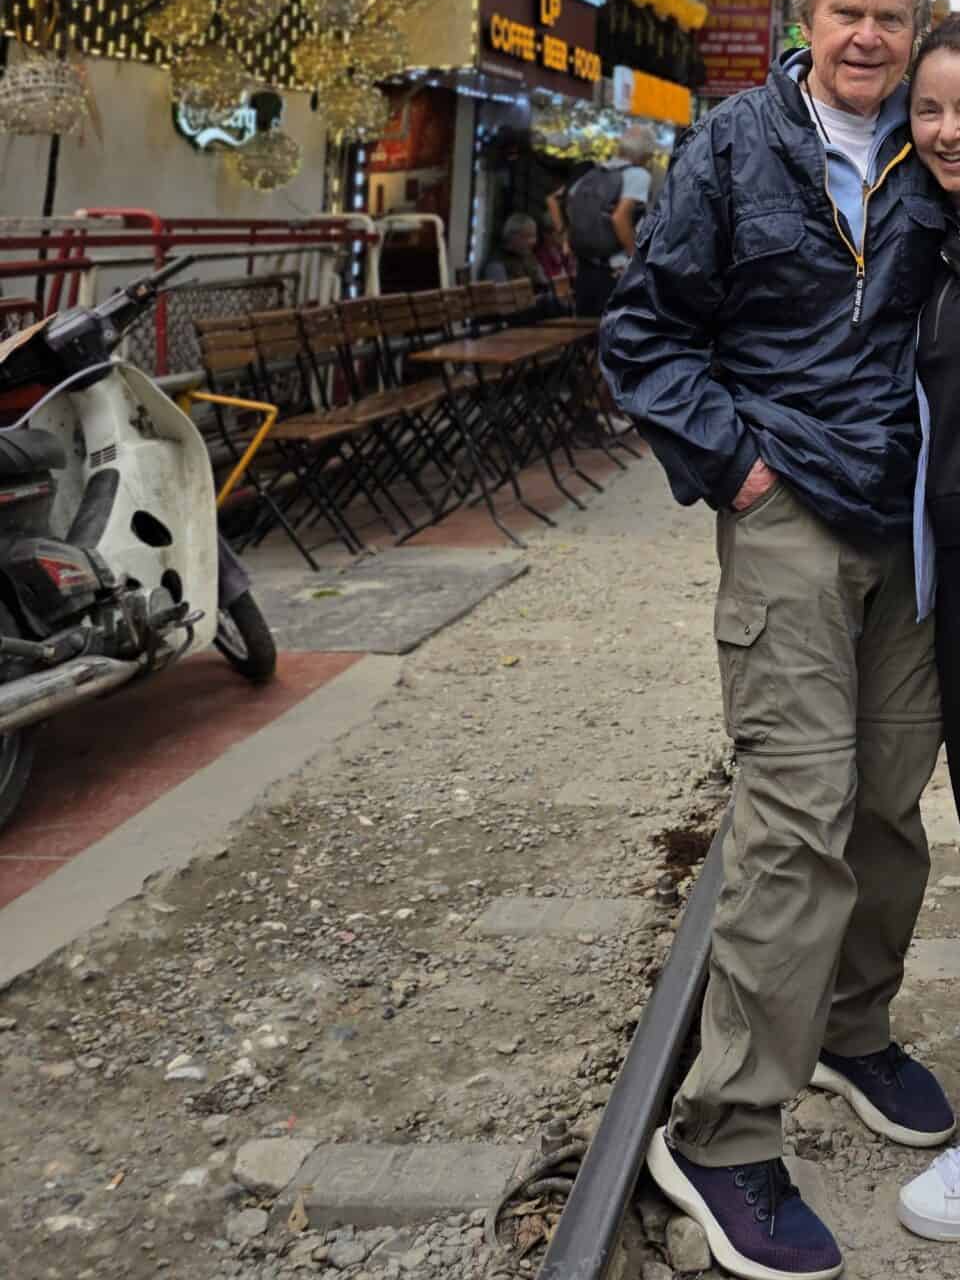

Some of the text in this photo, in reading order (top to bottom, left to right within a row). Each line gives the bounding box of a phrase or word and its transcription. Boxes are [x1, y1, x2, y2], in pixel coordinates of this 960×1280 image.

[491, 13, 601, 82] COFFEE BEER FOOD
